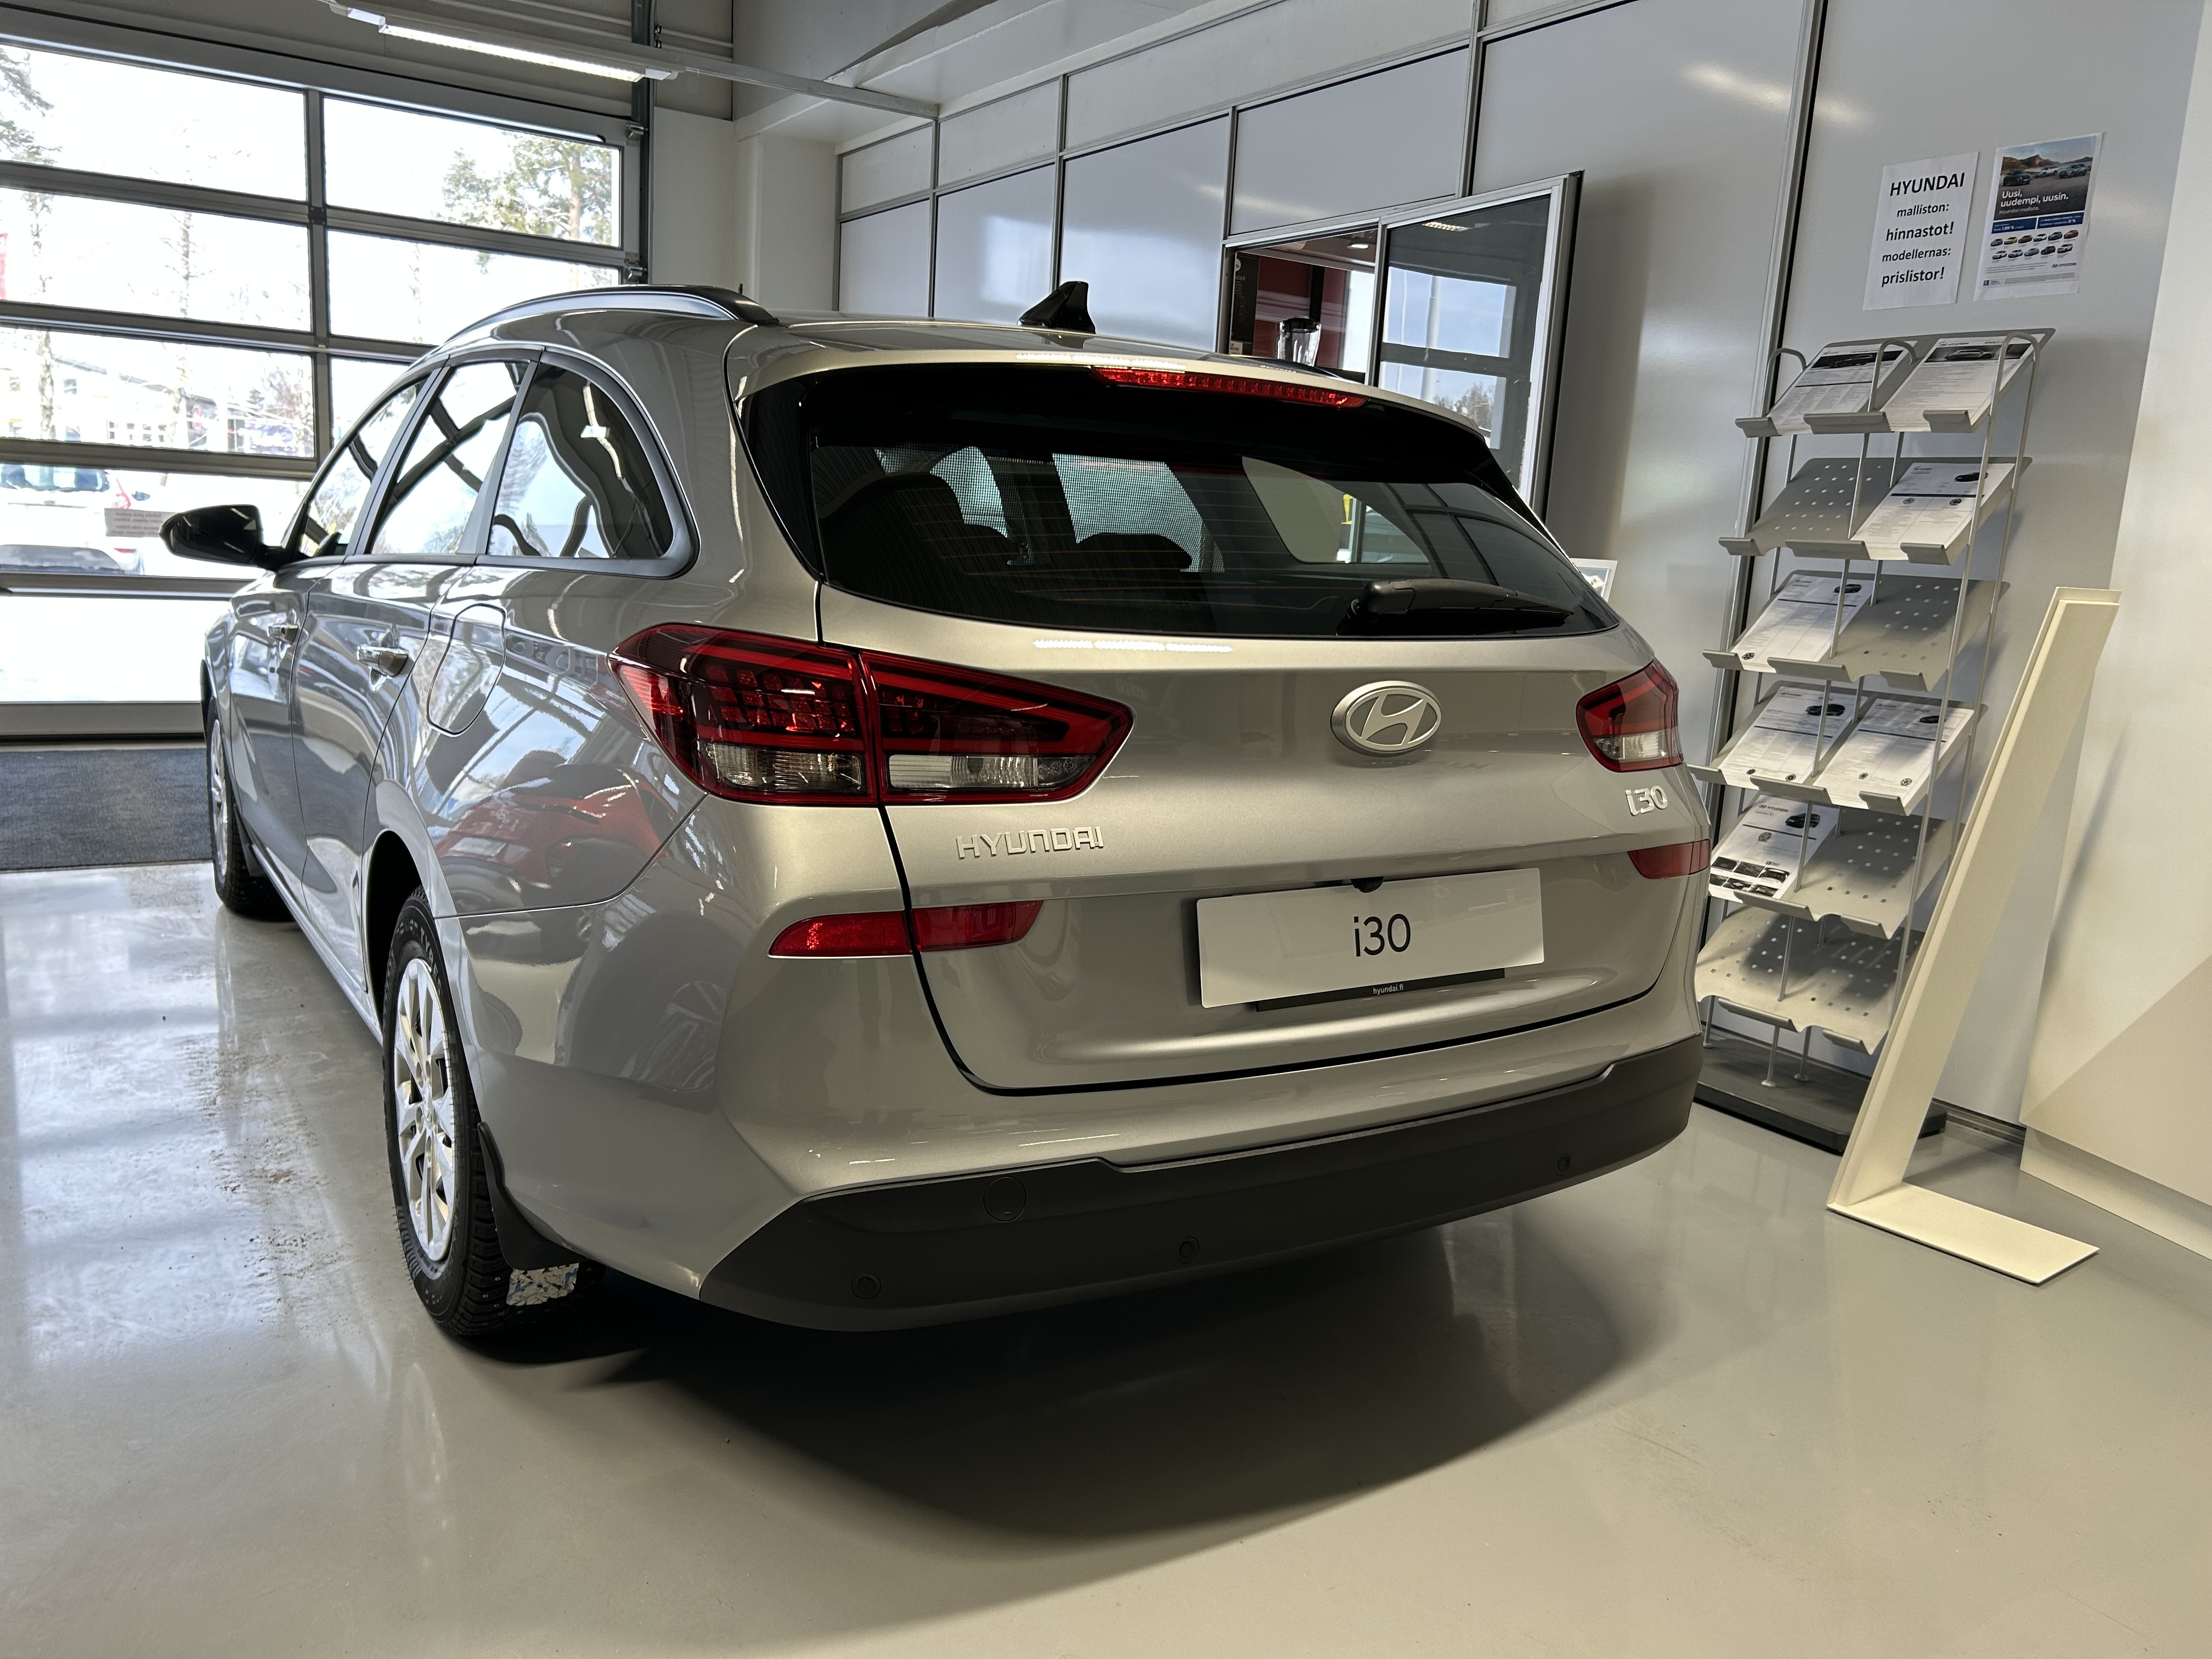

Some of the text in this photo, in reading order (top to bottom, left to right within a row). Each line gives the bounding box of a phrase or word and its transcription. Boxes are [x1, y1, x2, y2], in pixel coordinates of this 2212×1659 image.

[1889, 172, 1965, 197] HYUNDAI
[2002, 188, 2023, 199] Uusi,
[2000, 192, 2069, 207] uudempi, uusin.
[1897, 204, 1949, 218] malliston:
[1886, 221, 1955, 241] hinnastot!
[1882, 248, 1951, 262] modellernas:
[1881, 266, 1945, 287] prislistor!
[1624, 785, 1668, 816] i30
[956, 826, 1104, 860] HYUNDAI
[1353, 913, 1411, 957] i30
[1372, 983, 1404, 996] hyundai.fi
